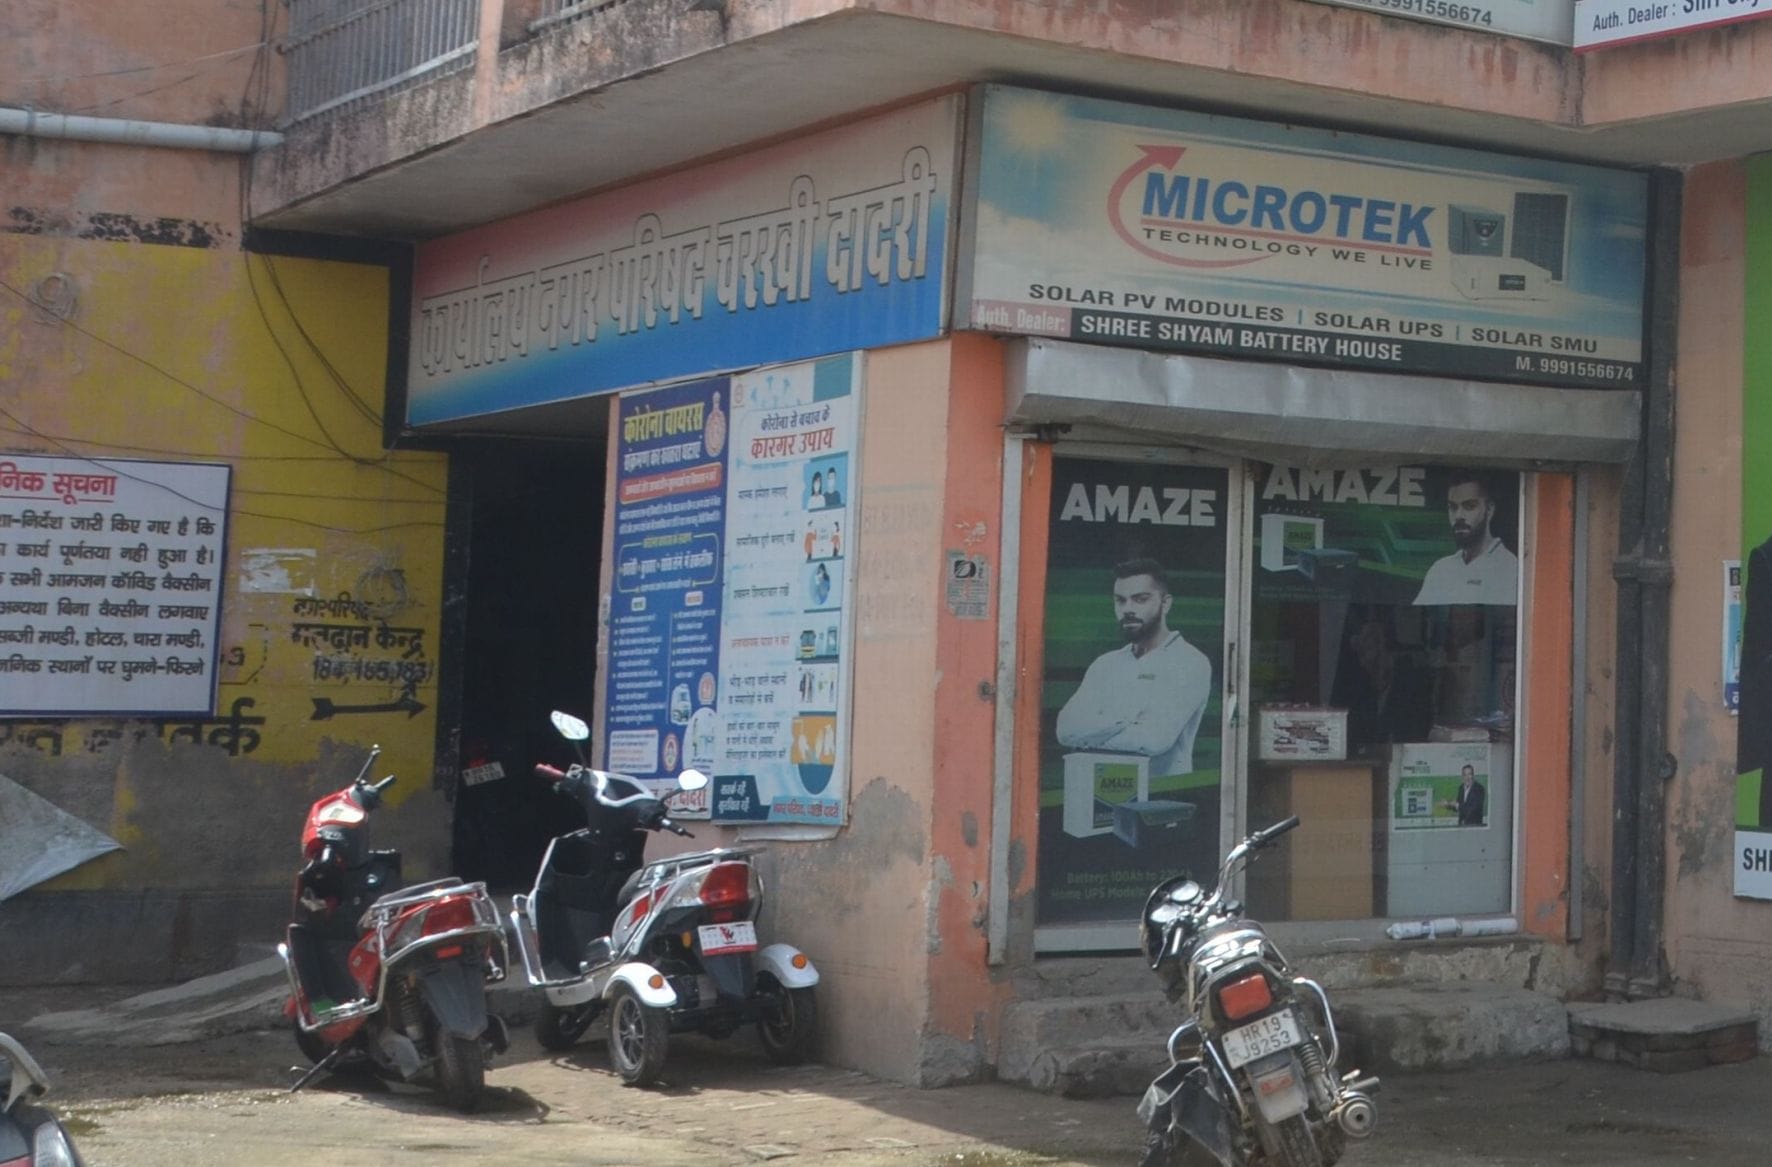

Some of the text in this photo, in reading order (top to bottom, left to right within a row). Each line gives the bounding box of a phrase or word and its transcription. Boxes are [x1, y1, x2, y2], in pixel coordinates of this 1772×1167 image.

[1593, 12, 1623, 31] Auth.
[1142, 172, 1436, 249] MICROTEK
[420, 145, 936, 376] कार्यालय चरखी दादरी
[1143, 227, 1433, 271] TECHNOLOGY WE LIVE
[1029, 284, 1598, 354] SOLAR PV MODULES SOLAR UPS SOLAR SMU
[1081, 314, 1402, 362] SHREE SHYAM BATTERY HOUSE
[1540, 357, 1634, 382] 9991556674
[761, 411, 788, 431] कोरोना
[752, 427, 835, 459] कारगर उपाय
[53, 473, 117, 504] सूचना
[1262, 464, 1426, 507] AMAZE
[1060, 483, 1216, 527] AMAZE
[71, 512, 216, 536] जारी किए गए है कि
[17, 539, 187, 569] कार्य पूर्णतया हुआ
[10, 568, 212, 592] सभी आमजन वैक्सीन
[57, 597, 150, 618] बिना वैक्सीन
[97, 660, 116, 675] पर
